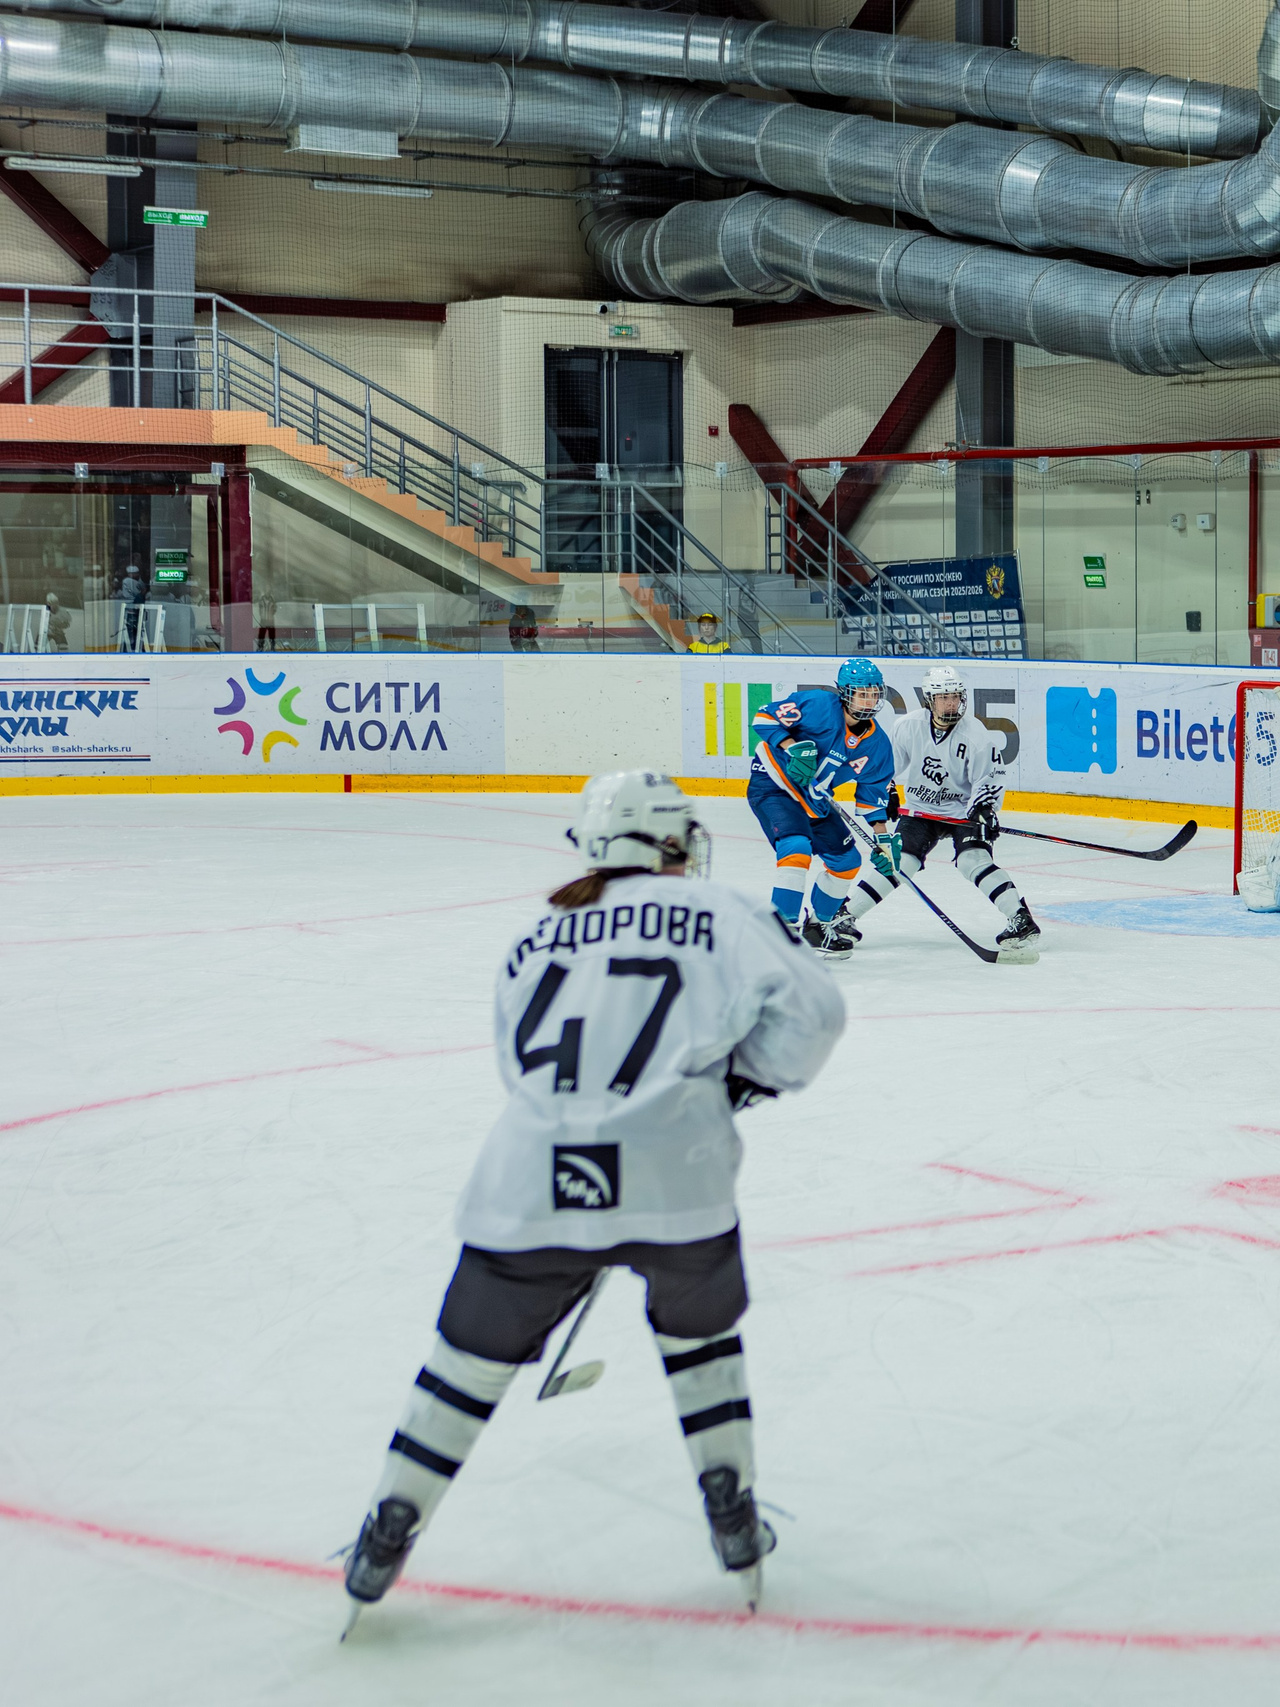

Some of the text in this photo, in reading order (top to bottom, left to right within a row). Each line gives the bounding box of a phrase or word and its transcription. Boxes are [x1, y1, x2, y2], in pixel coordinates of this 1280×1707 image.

[179, 214, 205, 222] ВЫХОД
[898, 575, 924, 585] РОССИИ
[924, 573, 935, 583] ПО
[912, 589, 929, 599] ЛИГА
[950, 585, 983, 597] 2025/2026
[325, 682, 440, 713] СИТИ
[775, 702, 802, 727] 42
[320, 720, 448, 751] МОЛЛ
[60, 744, 132, 753] sakh-sharks.ru
[956, 742, 967, 760] A
[848, 756, 869, 774] A
[515, 956, 684, 1098] 47
